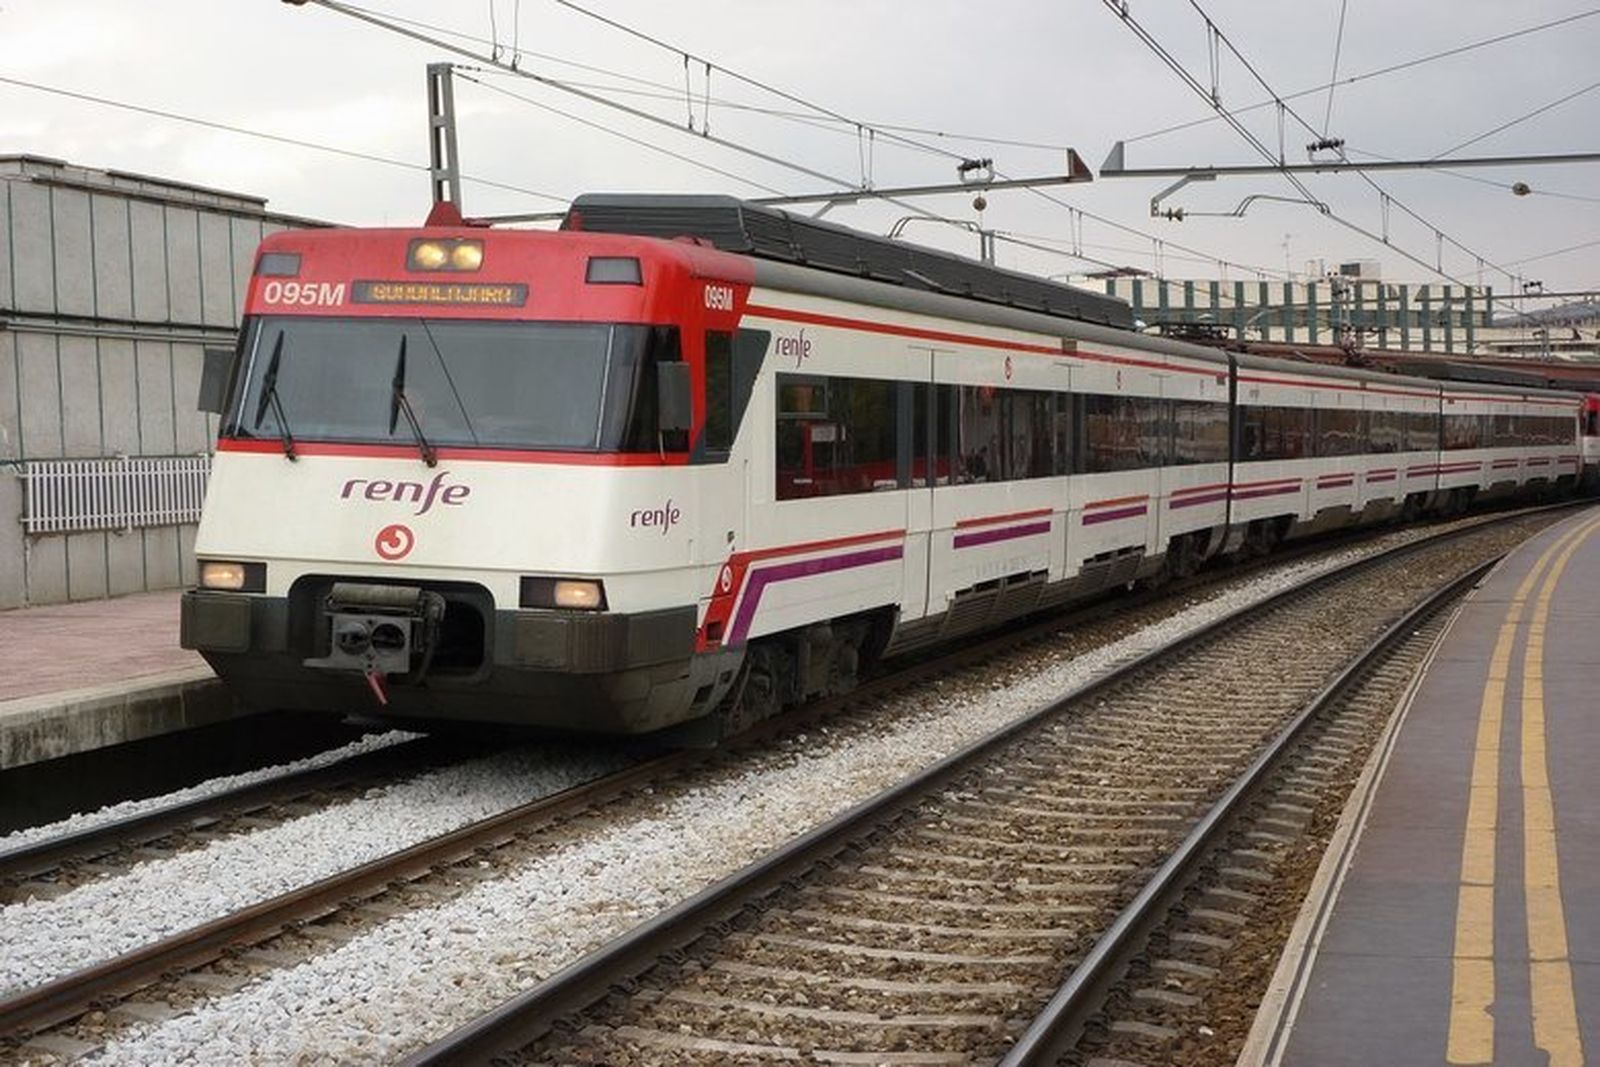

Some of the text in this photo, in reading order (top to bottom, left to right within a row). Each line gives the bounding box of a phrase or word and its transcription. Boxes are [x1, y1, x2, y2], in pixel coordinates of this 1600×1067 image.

[264, 281, 345, 306] 095M
[704, 285, 733, 311] 095M
[774, 328, 812, 369] renfe
[340, 471, 471, 516] renfe
[630, 499, 680, 536] renfe
